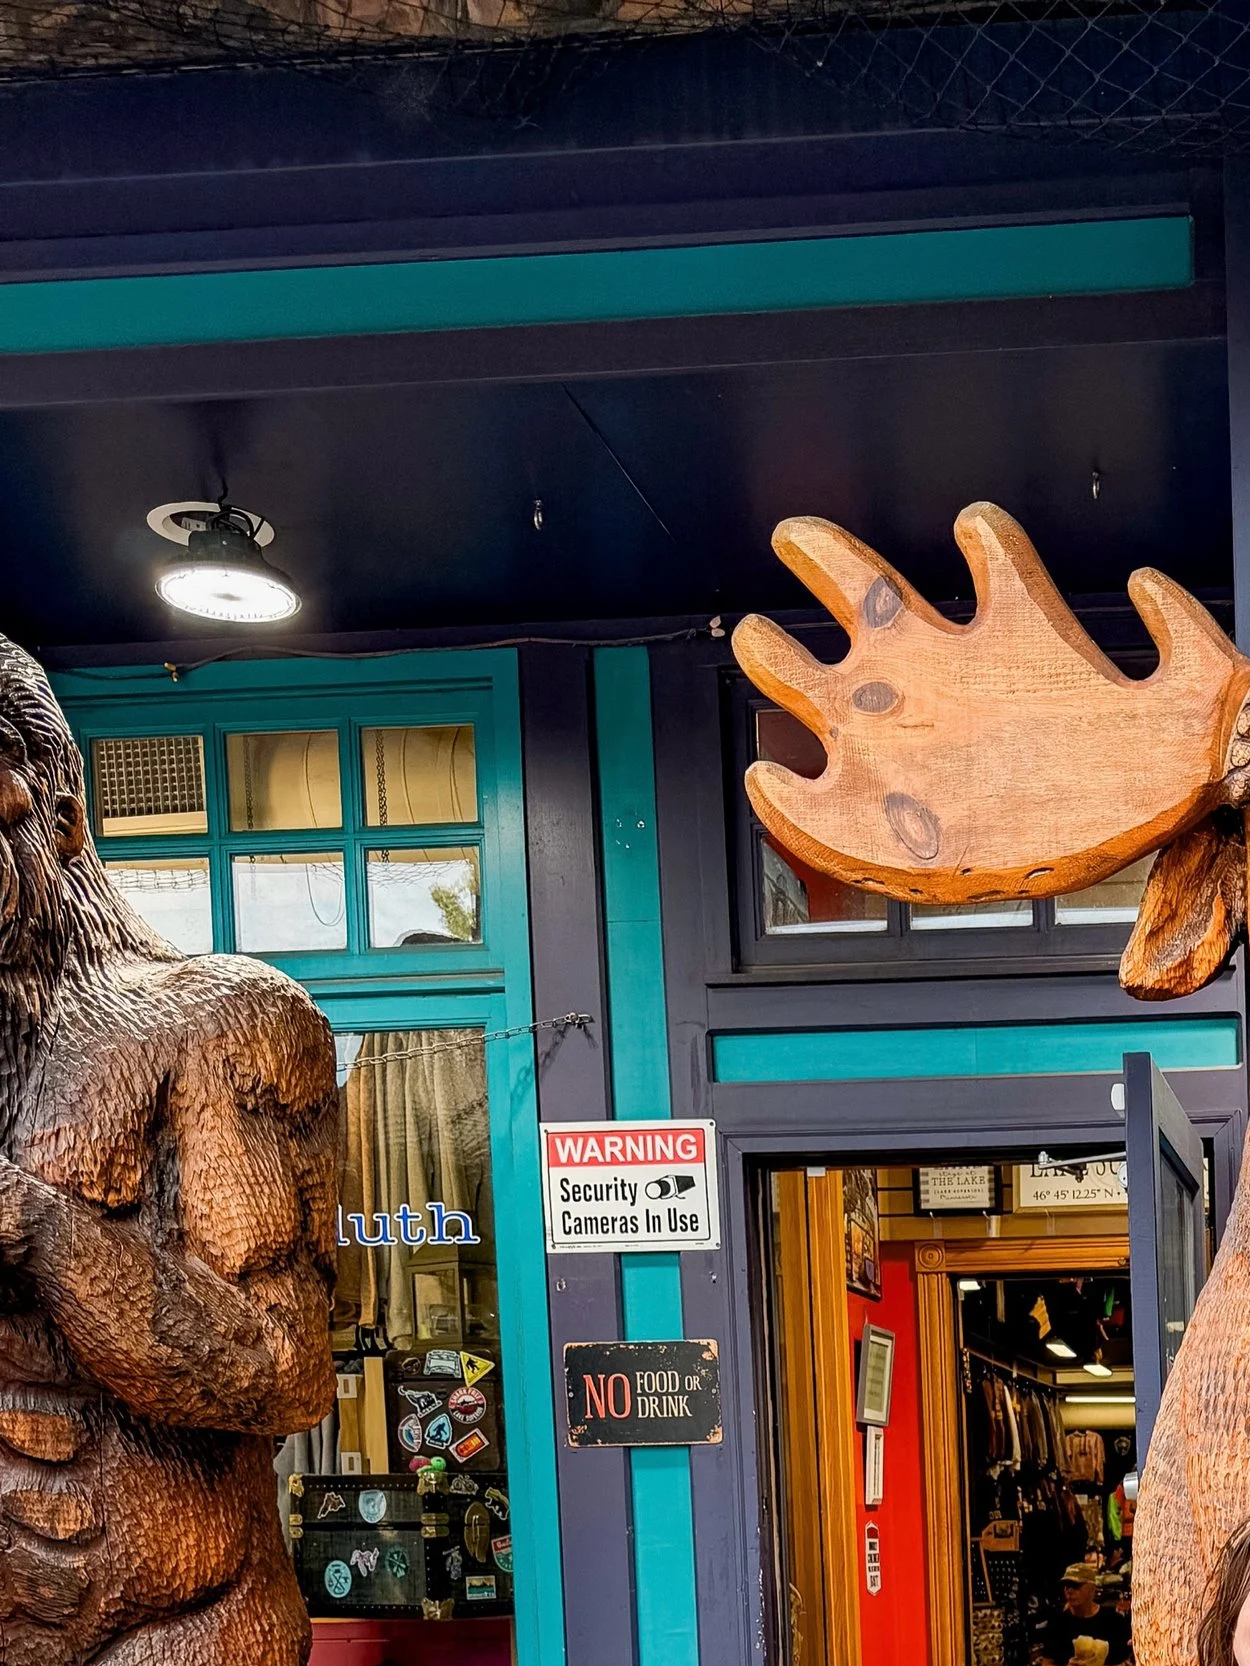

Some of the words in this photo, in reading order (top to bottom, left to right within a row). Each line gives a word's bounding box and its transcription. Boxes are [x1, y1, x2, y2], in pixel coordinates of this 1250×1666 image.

[555, 1133, 698, 1164] WARNING
[560, 1176, 638, 1207] Security
[931, 1176, 954, 1187] THE
[957, 1175, 986, 1186] LAKE
[1104, 1188, 1114, 1198] N
[562, 1210, 639, 1235] Cameras
[645, 1208, 662, 1233] In
[667, 1207, 700, 1233] Use
[582, 1372, 632, 1419] NO
[635, 1370, 680, 1394] FOOD
[684, 1375, 703, 1391] OR
[636, 1395, 693, 1419] DRINK
